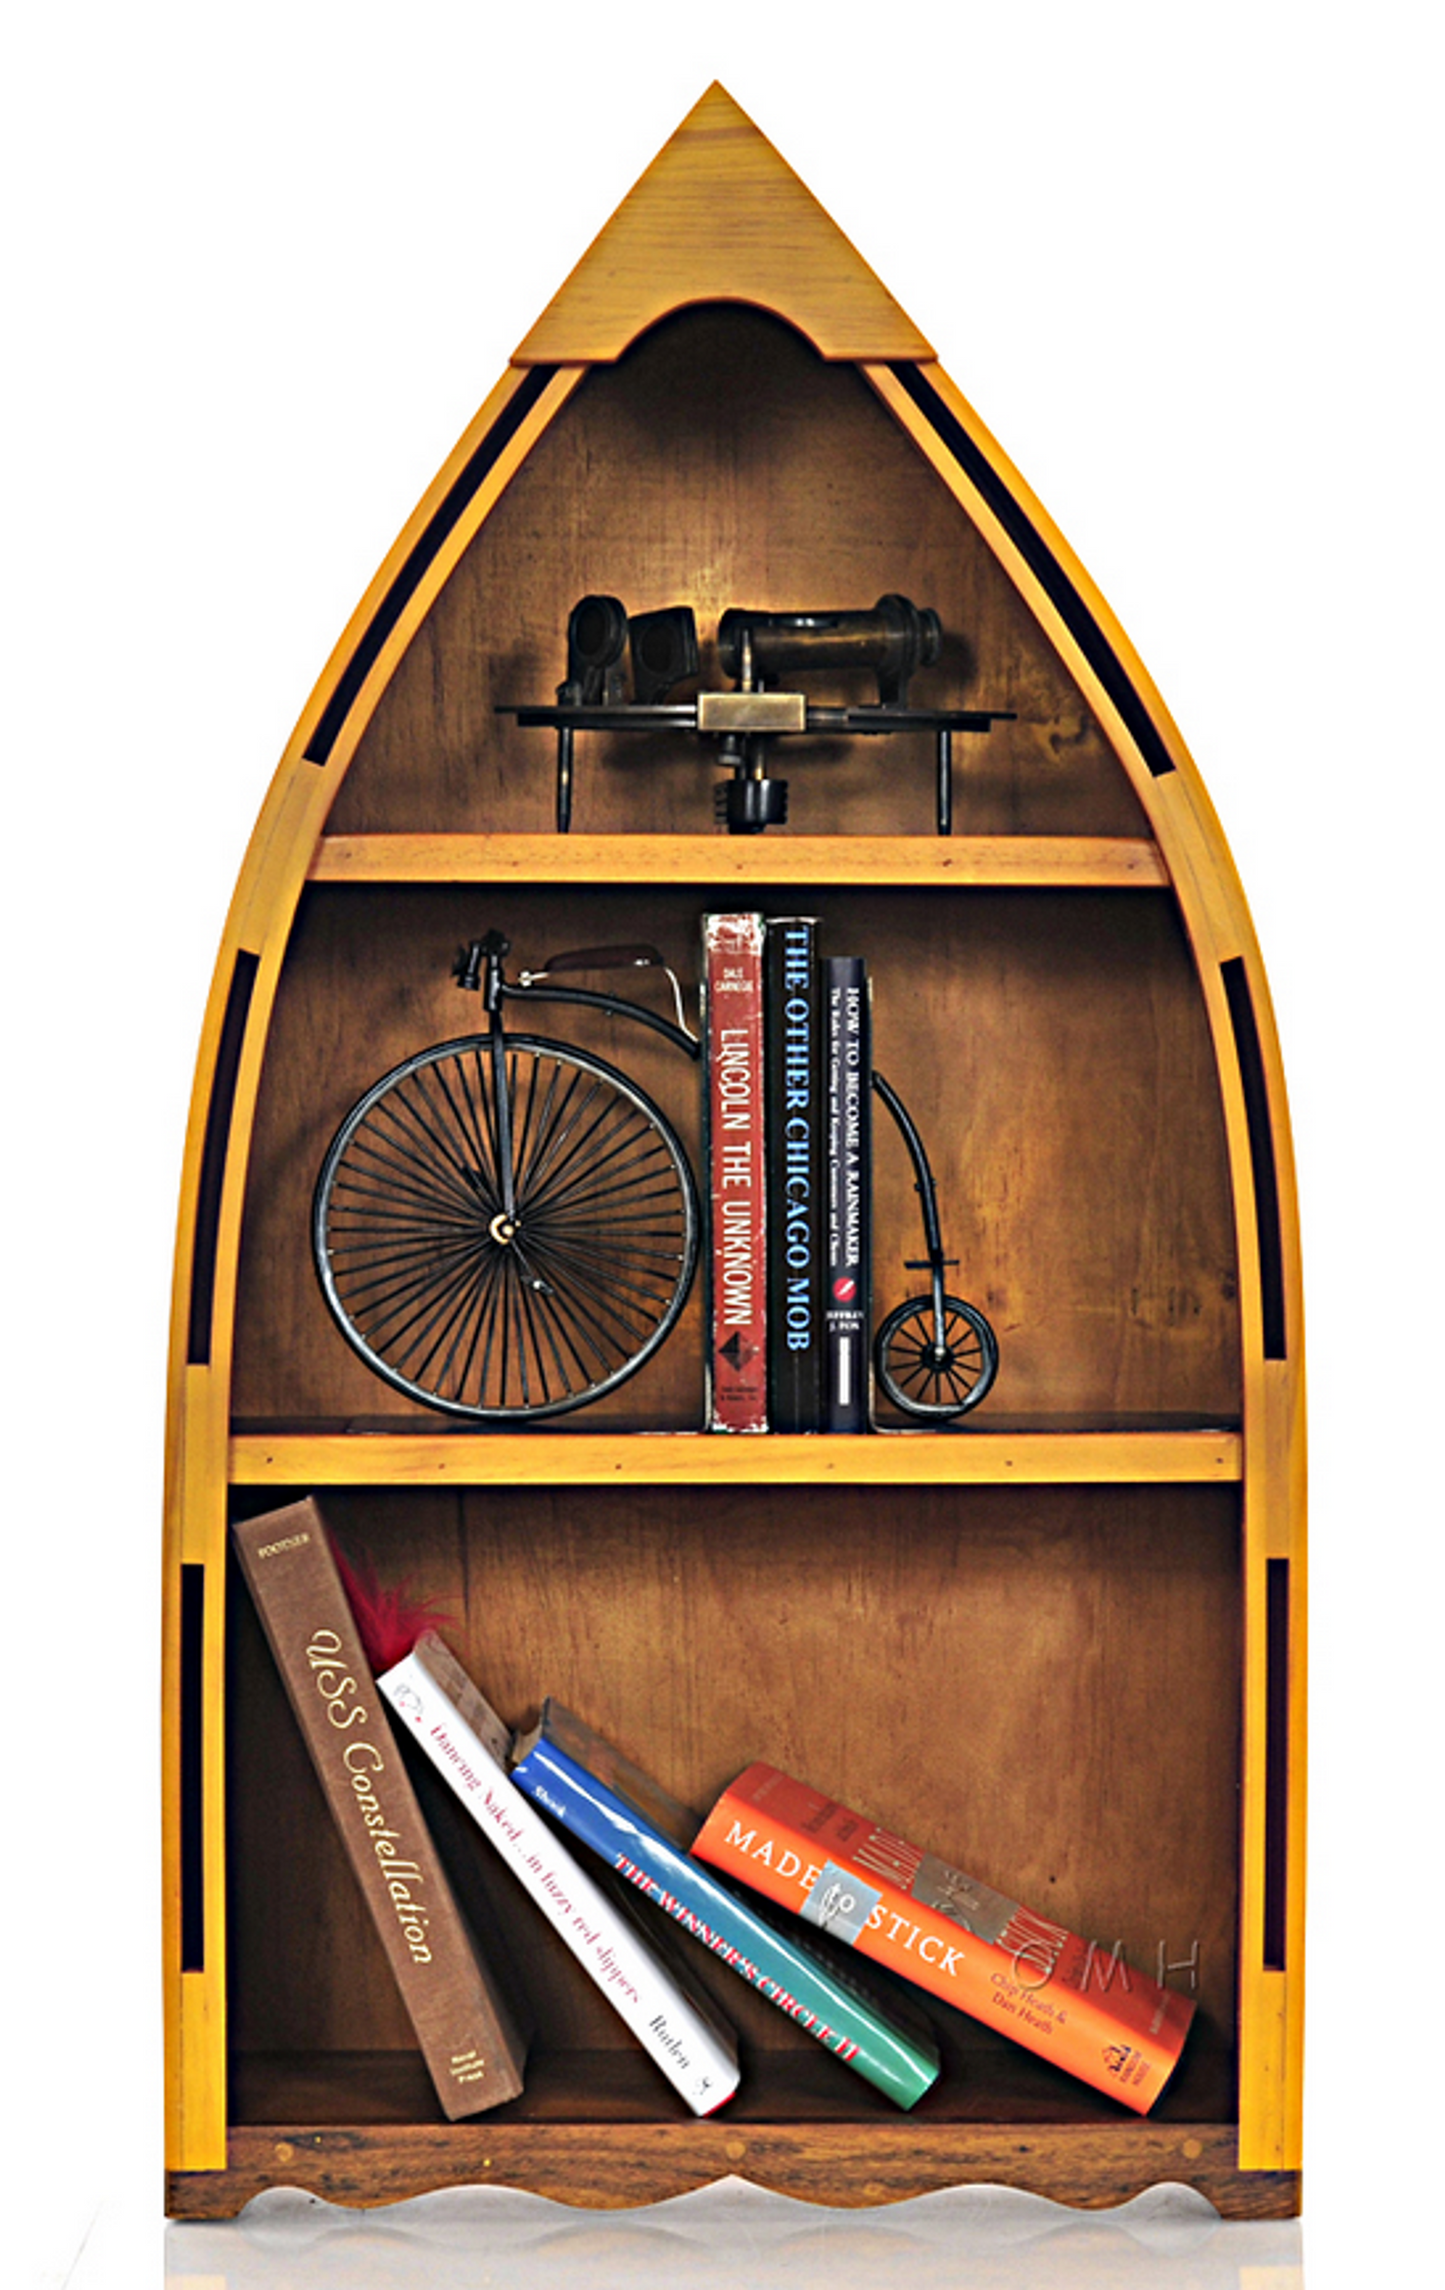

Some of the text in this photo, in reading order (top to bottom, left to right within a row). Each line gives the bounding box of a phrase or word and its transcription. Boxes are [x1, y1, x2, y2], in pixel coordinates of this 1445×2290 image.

[717, 1029, 753, 1326] LINCOLN THE UNKNOWN
[784, 925, 811, 1351] THE OTHER CHICAGO MOB
[845, 987, 859, 1267] HOW TO BECOME A RAINMAKER
[306, 1629, 433, 1965] USS Constellation
[430, 1722, 483, 1792] Dancing
[540, 1870, 578, 1917] fuzzy
[572, 1914, 602, 1947] red
[596, 1941, 638, 2004] slippers
[724, 1819, 822, 1892] MADE
[864, 1904, 965, 1977] STICK
[615, 1853, 660, 1897] THE
[660, 1890, 760, 1982] WINNER'S
[757, 1976, 838, 2045] CIRCLE
